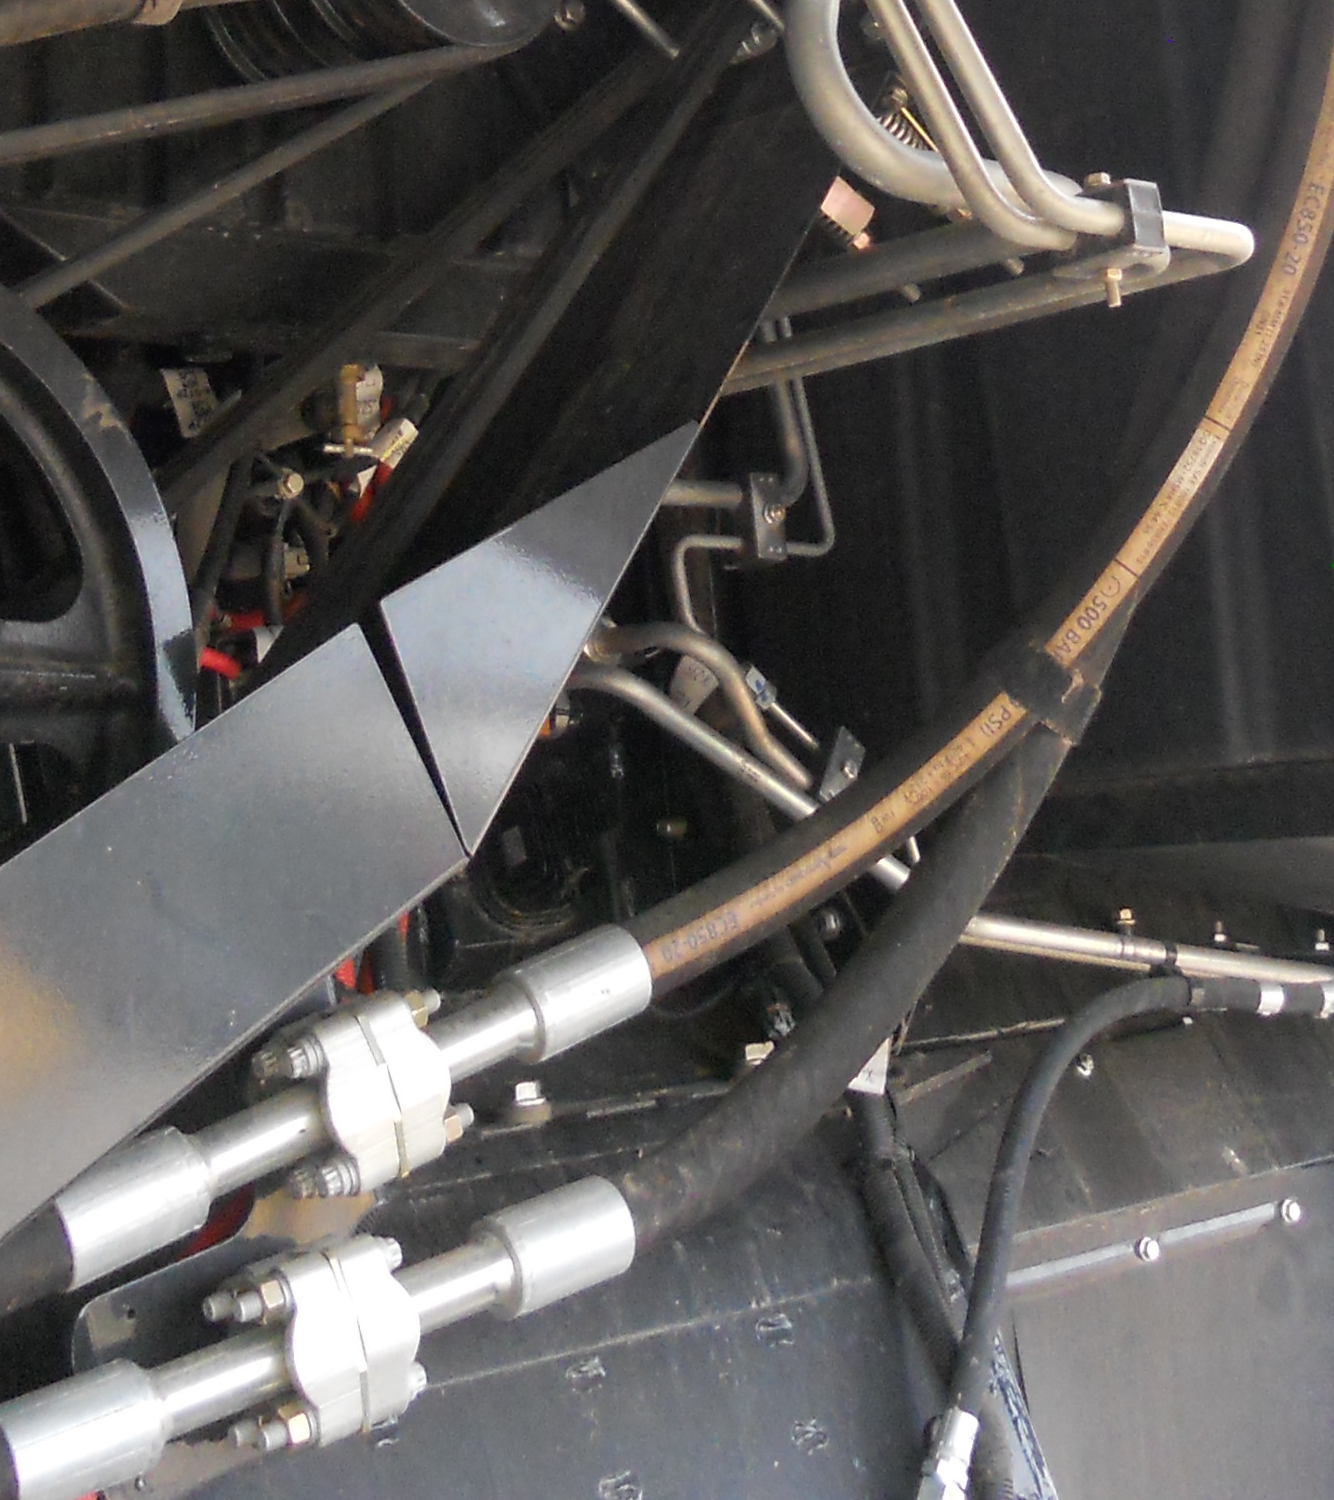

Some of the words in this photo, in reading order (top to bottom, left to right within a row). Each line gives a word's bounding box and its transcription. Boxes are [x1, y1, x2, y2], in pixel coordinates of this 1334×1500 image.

[1279, 182, 1325, 277] EC850-20
[1073, 594, 1108, 632] 500
[976, 703, 1013, 739] PSI)
[657, 908, 742, 964] EC850-20
